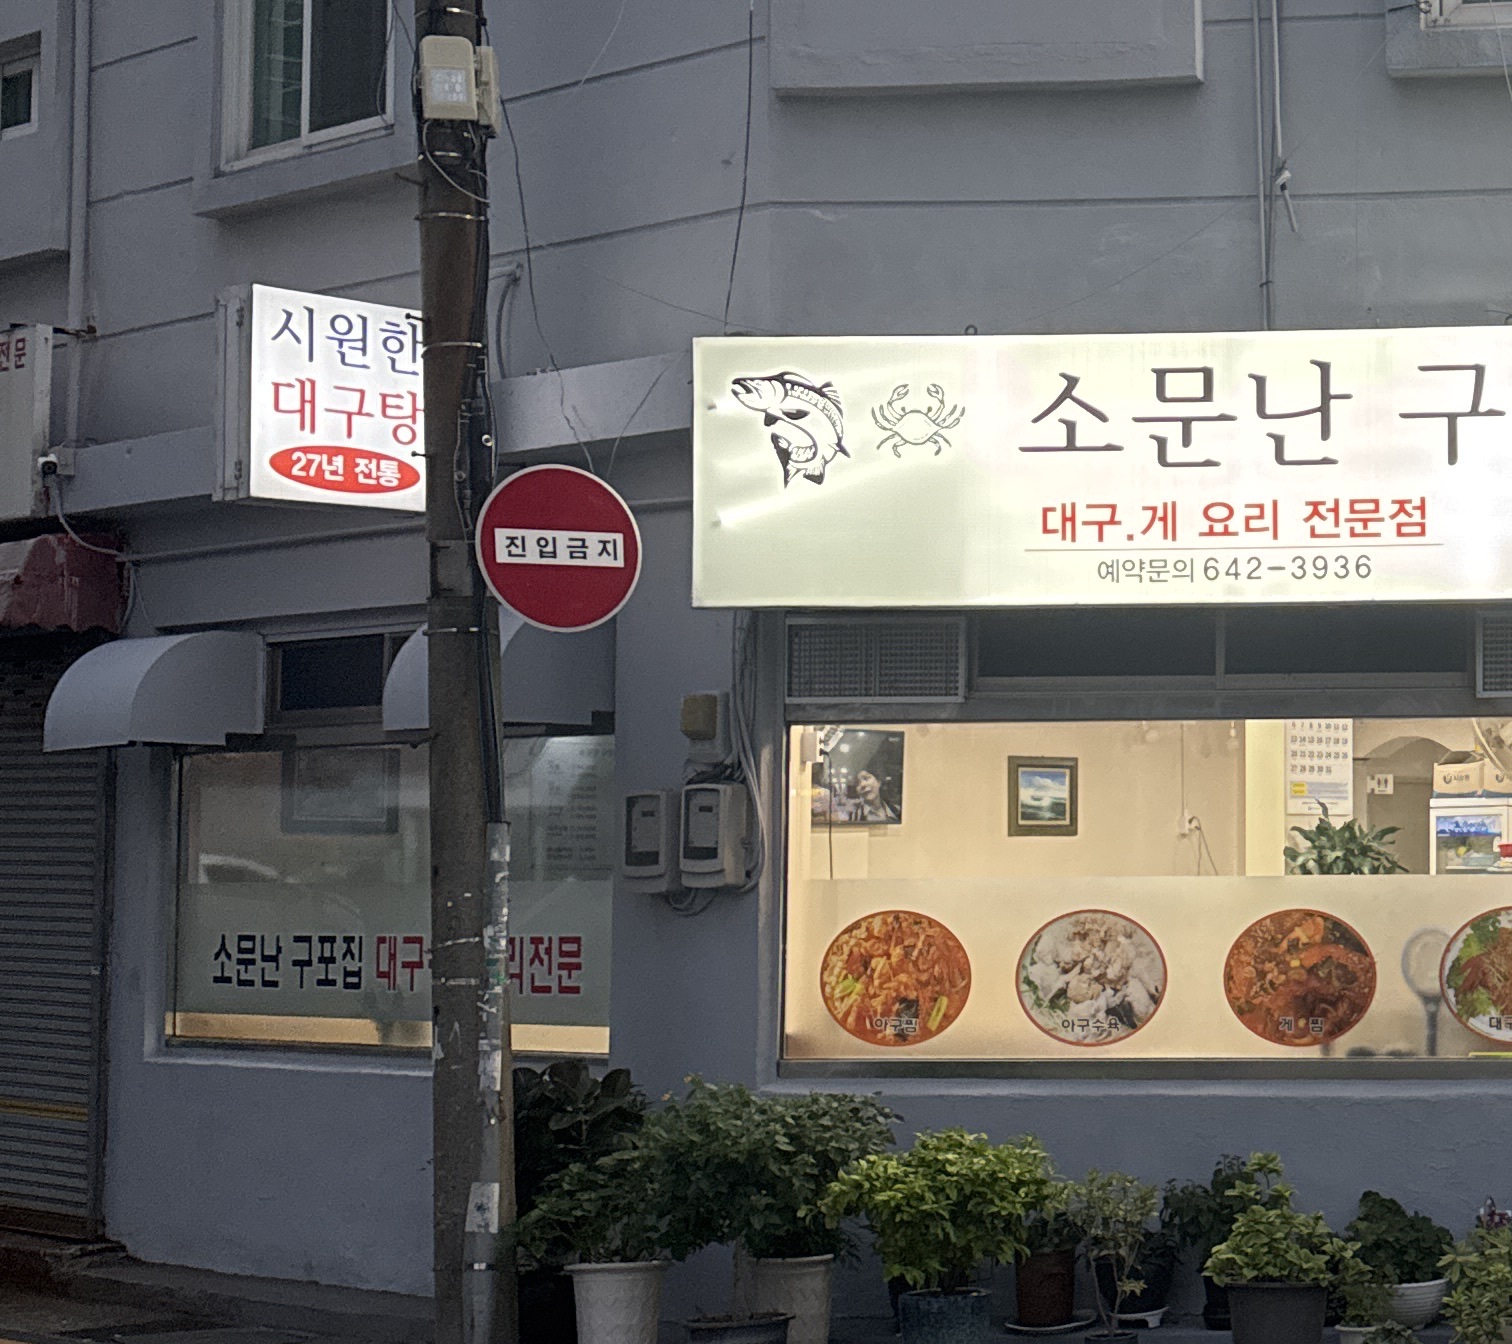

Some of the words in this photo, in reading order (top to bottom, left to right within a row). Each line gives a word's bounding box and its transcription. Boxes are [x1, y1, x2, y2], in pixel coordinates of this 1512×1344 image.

[271, 306, 423, 376] 시원한
[271, 378, 424, 446] 대구탕
[1018, 358, 1353, 468] 소문난
[291, 451, 344, 482] 27년
[354, 458, 401, 487] 전통
[1198, 498, 1280, 541] 요리
[1303, 496, 1428, 540] 전문점
[504, 536, 619, 561] 진입금지
[1096, 556, 1196, 584] 예약문의
[1203, 554, 1373, 582] 642-3936
[212, 934, 282, 988] 소문난
[291, 935, 363, 990] 구포집
[874, 1017, 919, 1033] 아구찜
[1061, 1017, 1121, 1033] 아구수육
